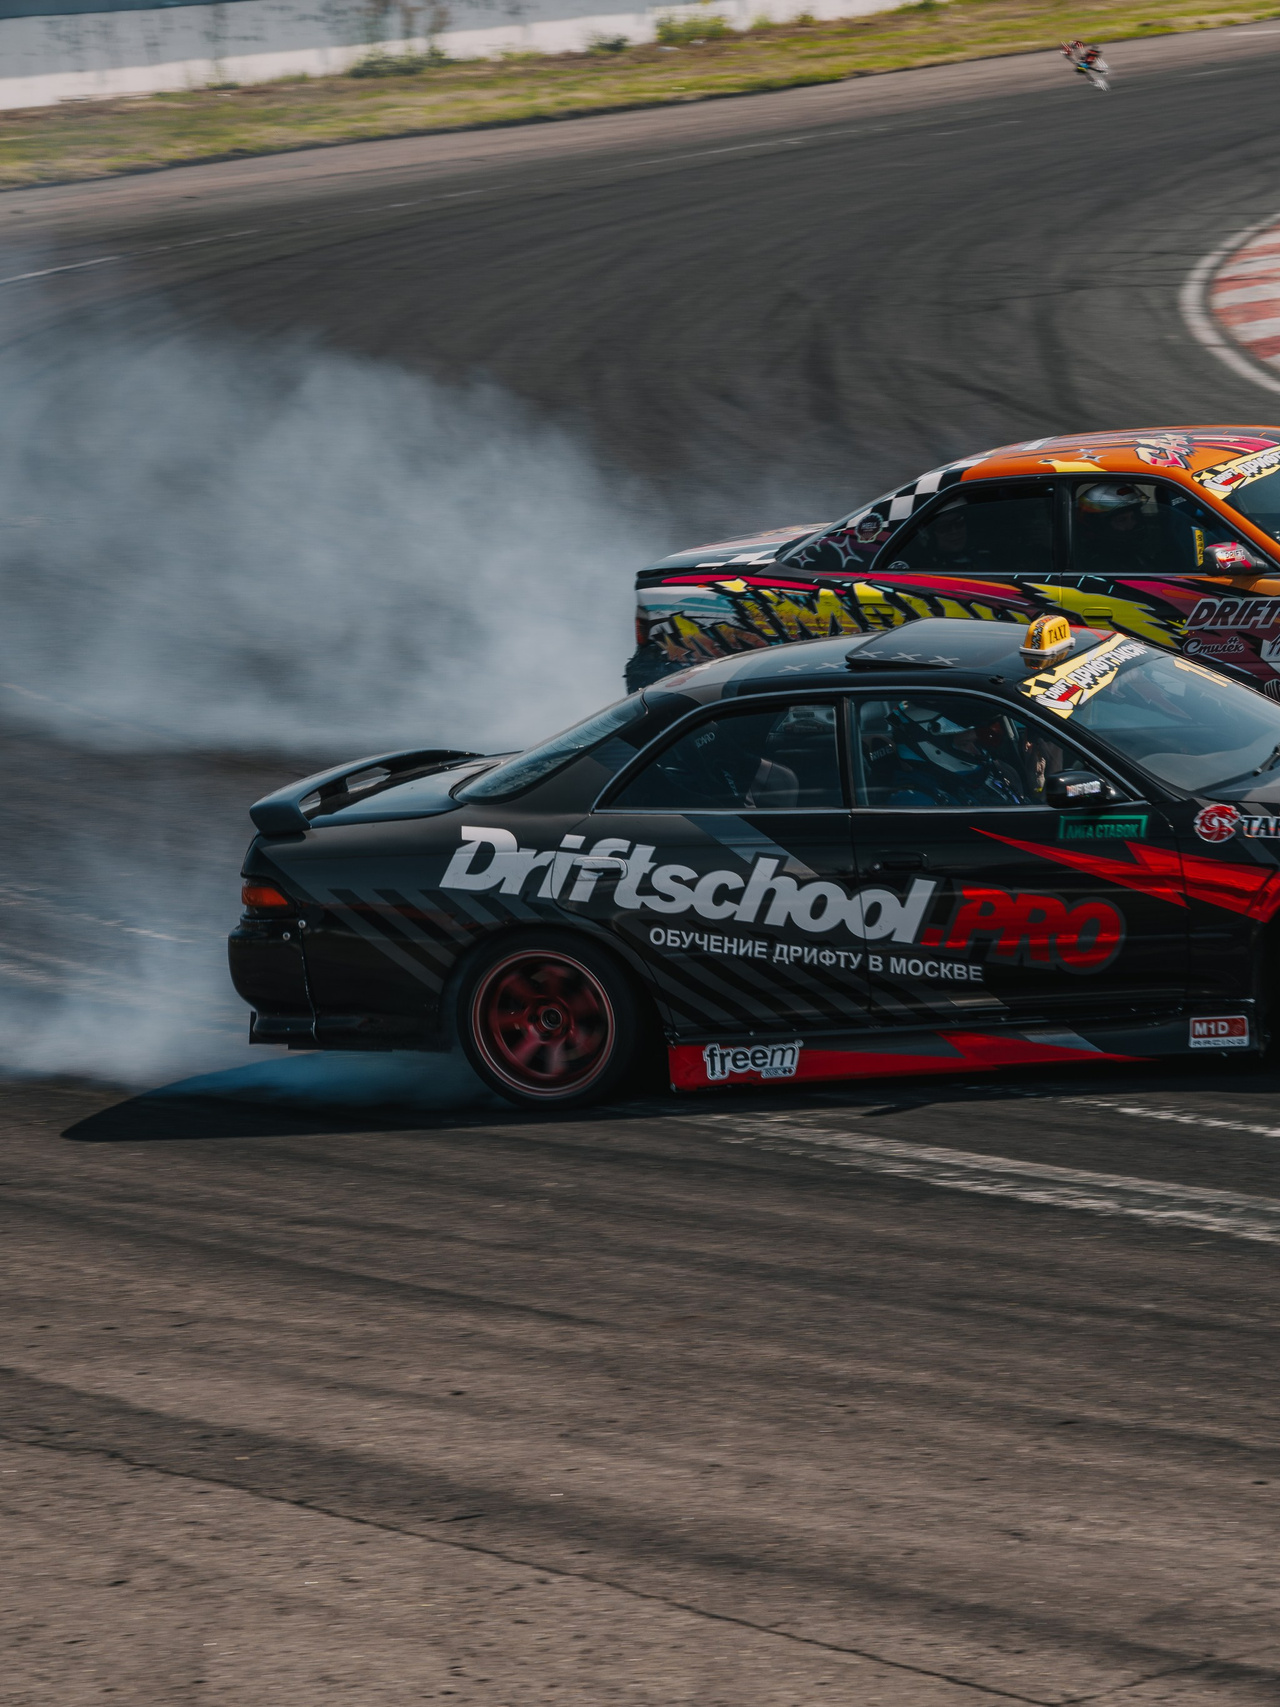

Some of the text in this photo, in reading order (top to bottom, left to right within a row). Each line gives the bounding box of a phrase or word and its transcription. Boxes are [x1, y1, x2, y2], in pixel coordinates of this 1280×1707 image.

[1048, 624, 1067, 644] TAXI
[1046, 678, 1073, 700] DRIFT
[1096, 824, 1139, 838] СТАВОК
[650, 927, 984, 982] ОБУЧЕНИЕ ДРИФТУ В МОСКВЕ
[1194, 1021, 1230, 1036] M1D
[707, 1045, 798, 1077] freem
